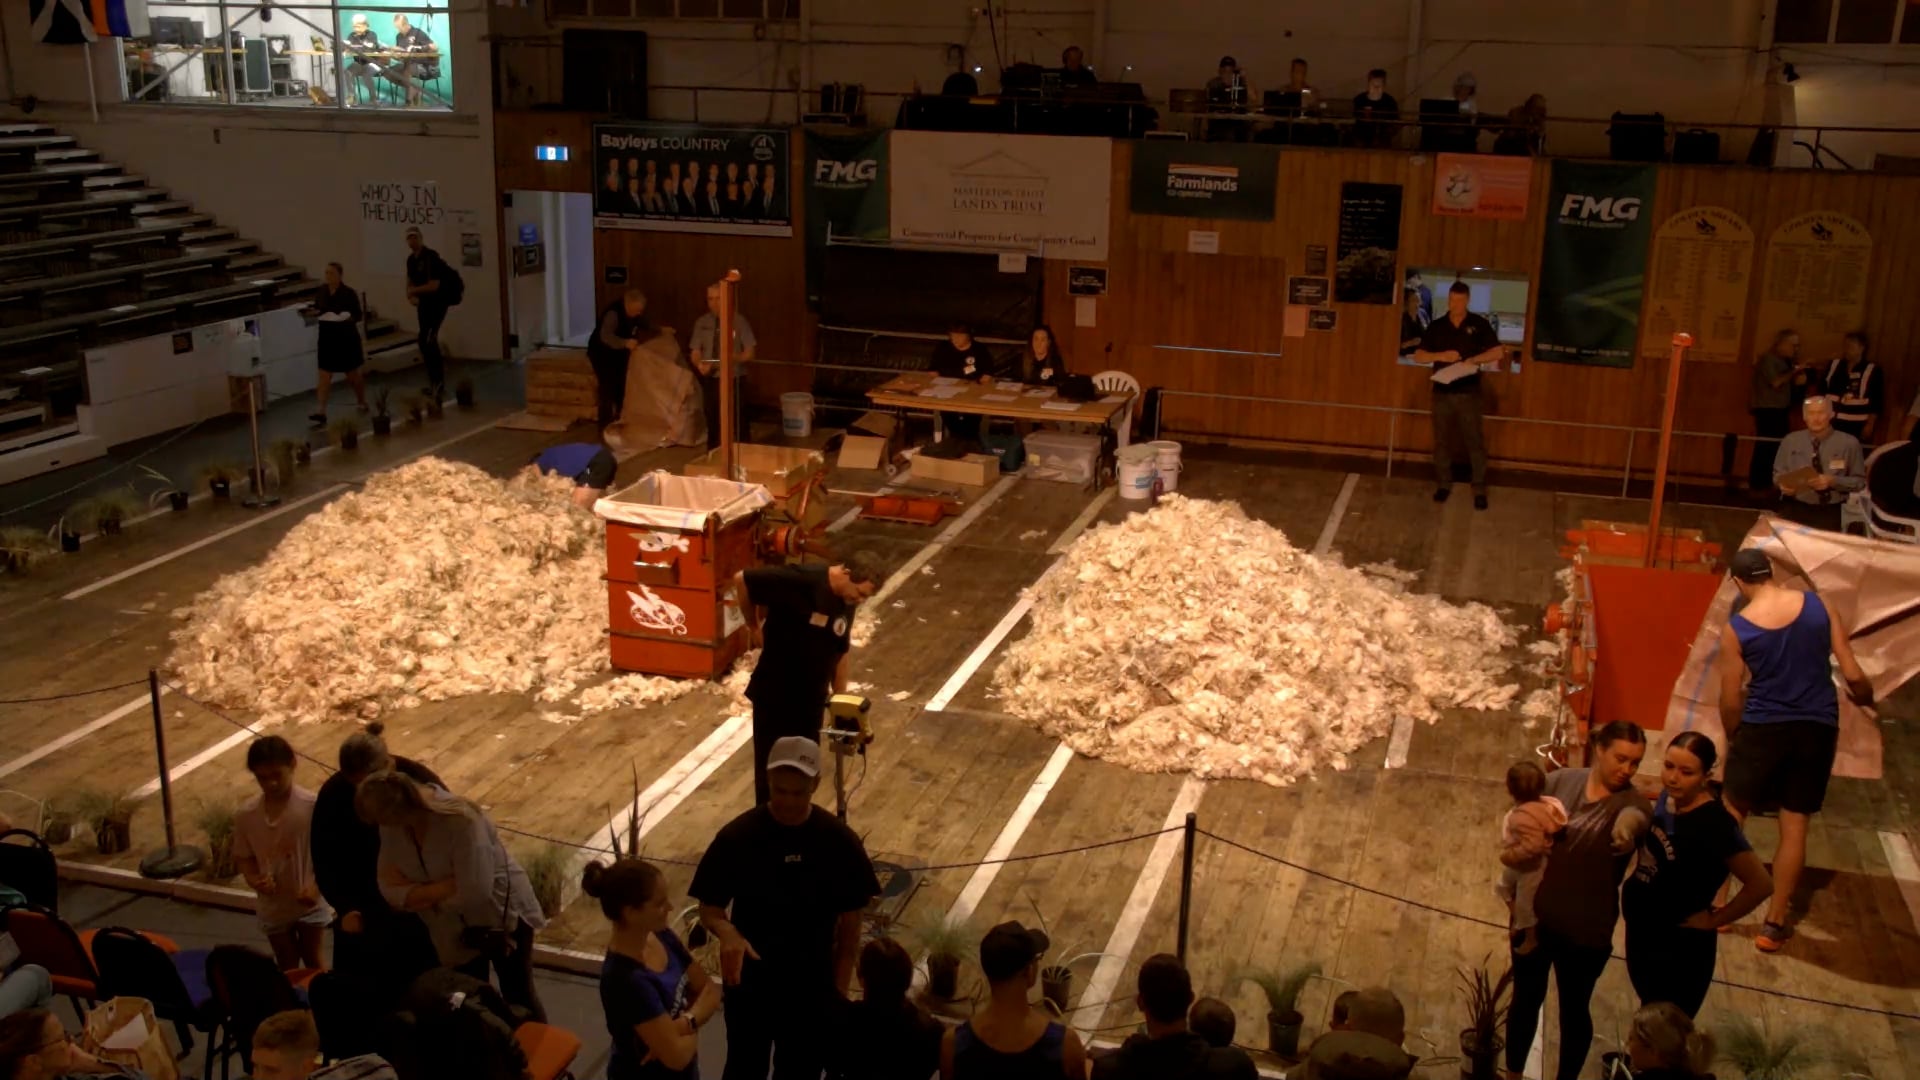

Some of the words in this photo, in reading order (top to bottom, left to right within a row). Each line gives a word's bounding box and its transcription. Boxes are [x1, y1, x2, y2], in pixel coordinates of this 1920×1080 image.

[600, 133, 658, 151] Bayleys
[660, 136, 731, 152] COUNTRY
[815, 159, 878, 182] FMG
[1167, 175, 1238, 192] Farmlands
[360, 184, 405, 203] WHO'S
[412, 186, 437, 206] IN
[953, 199, 998, 209] LANDS
[1000, 200, 1044, 211] TRUST
[1559, 193, 1641, 221] FMG
[958, 231, 997, 243] Property
[998, 233, 1012, 242] for
[1070, 235, 1097, 246] Good
